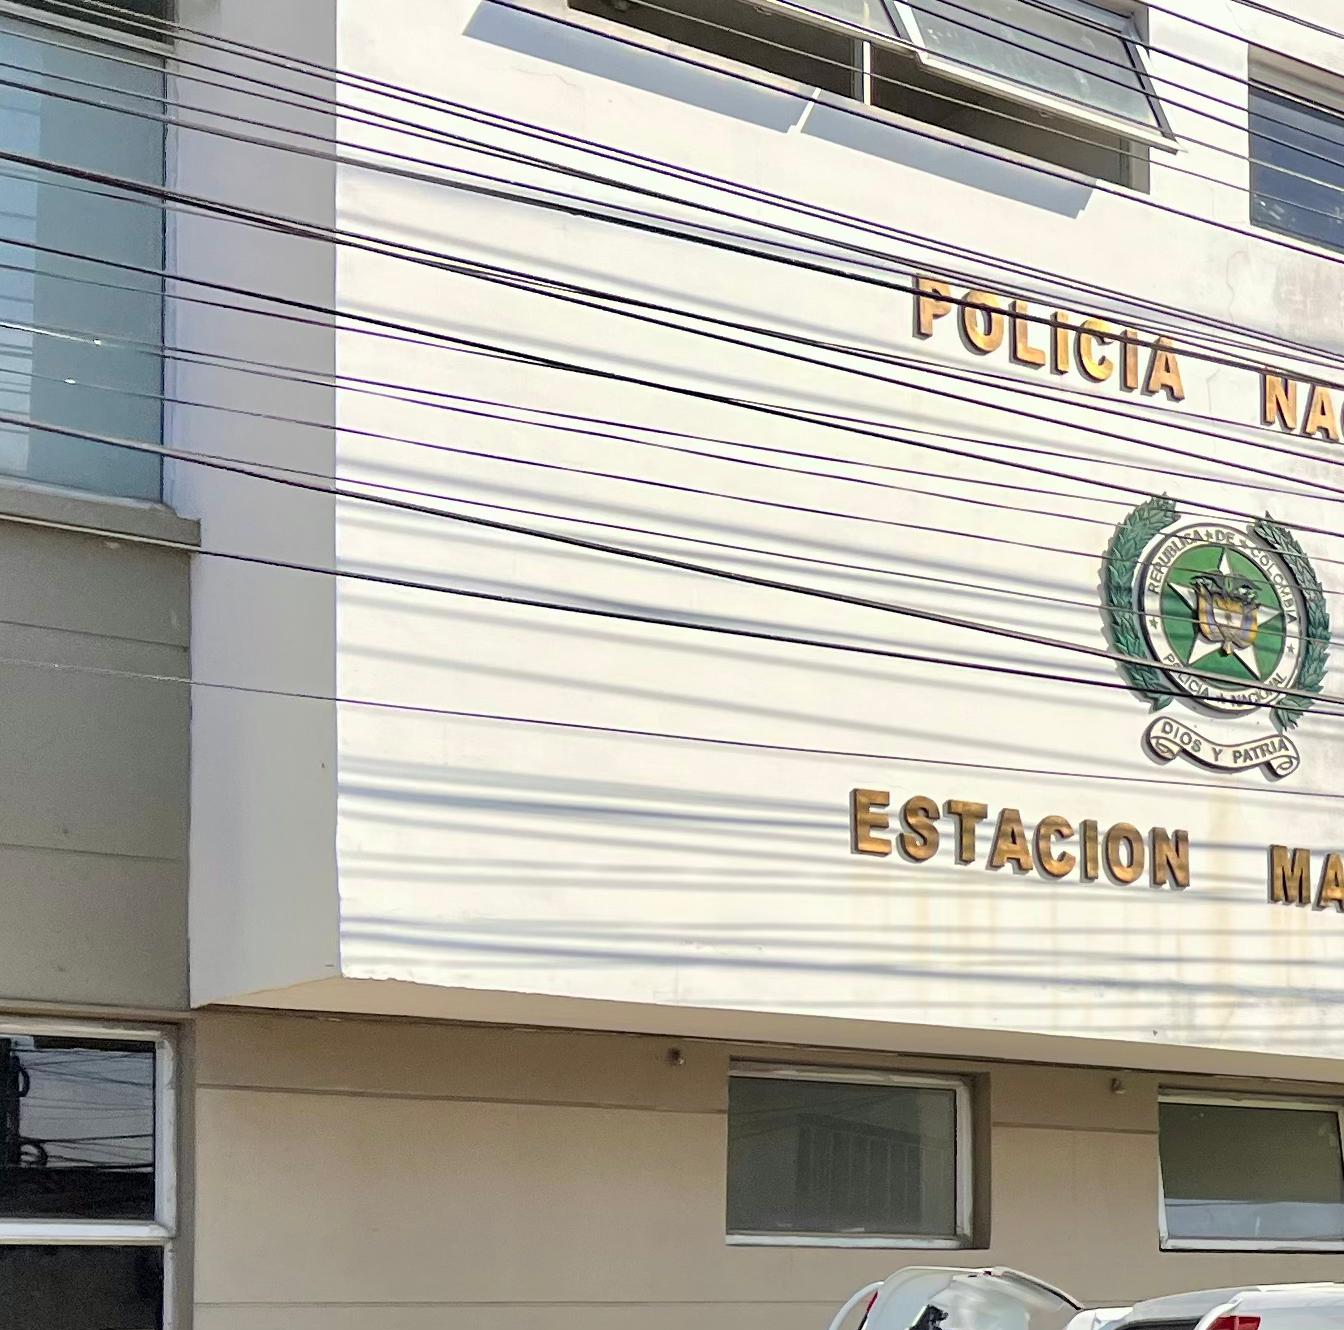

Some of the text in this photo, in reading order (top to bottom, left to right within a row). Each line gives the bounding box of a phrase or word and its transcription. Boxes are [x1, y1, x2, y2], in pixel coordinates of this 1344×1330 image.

[912, 272, 1185, 402] POLICIA
[1214, 530, 1236, 544] DE
[1251, 549, 1298, 624] COLOMBIA
[1161, 721, 1290, 764] DIOS Y PATRIA
[849, 788, 1191, 890] ESTACION
